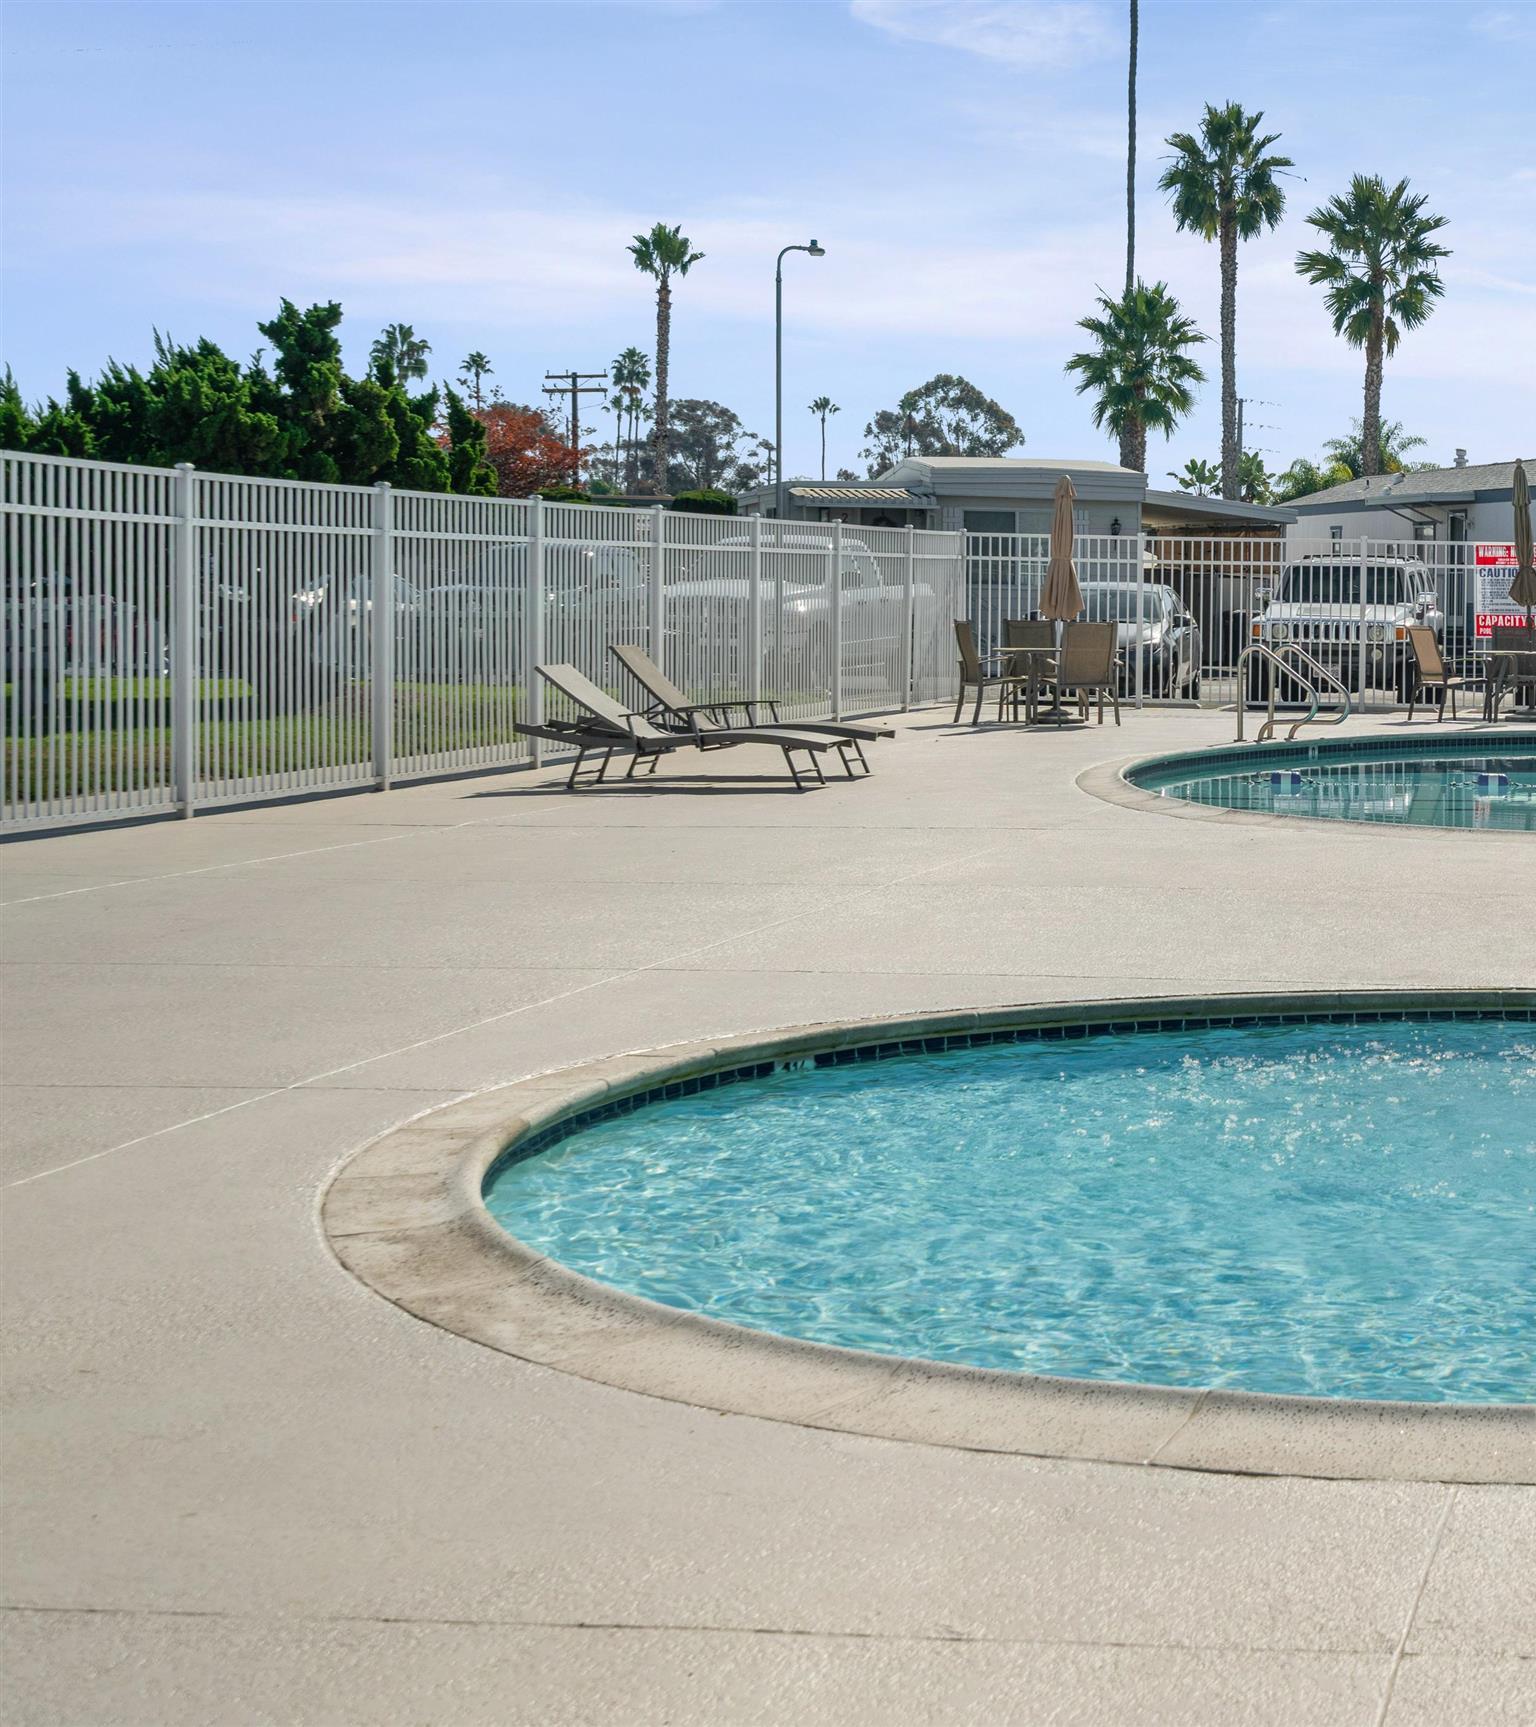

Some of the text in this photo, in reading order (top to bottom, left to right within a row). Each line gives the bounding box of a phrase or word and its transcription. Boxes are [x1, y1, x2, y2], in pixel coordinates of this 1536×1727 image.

[1478, 546, 1509, 557] WARNING:
[1479, 568, 1517, 578] CAUTIO
[1479, 616, 1527, 627] CAPACITY
